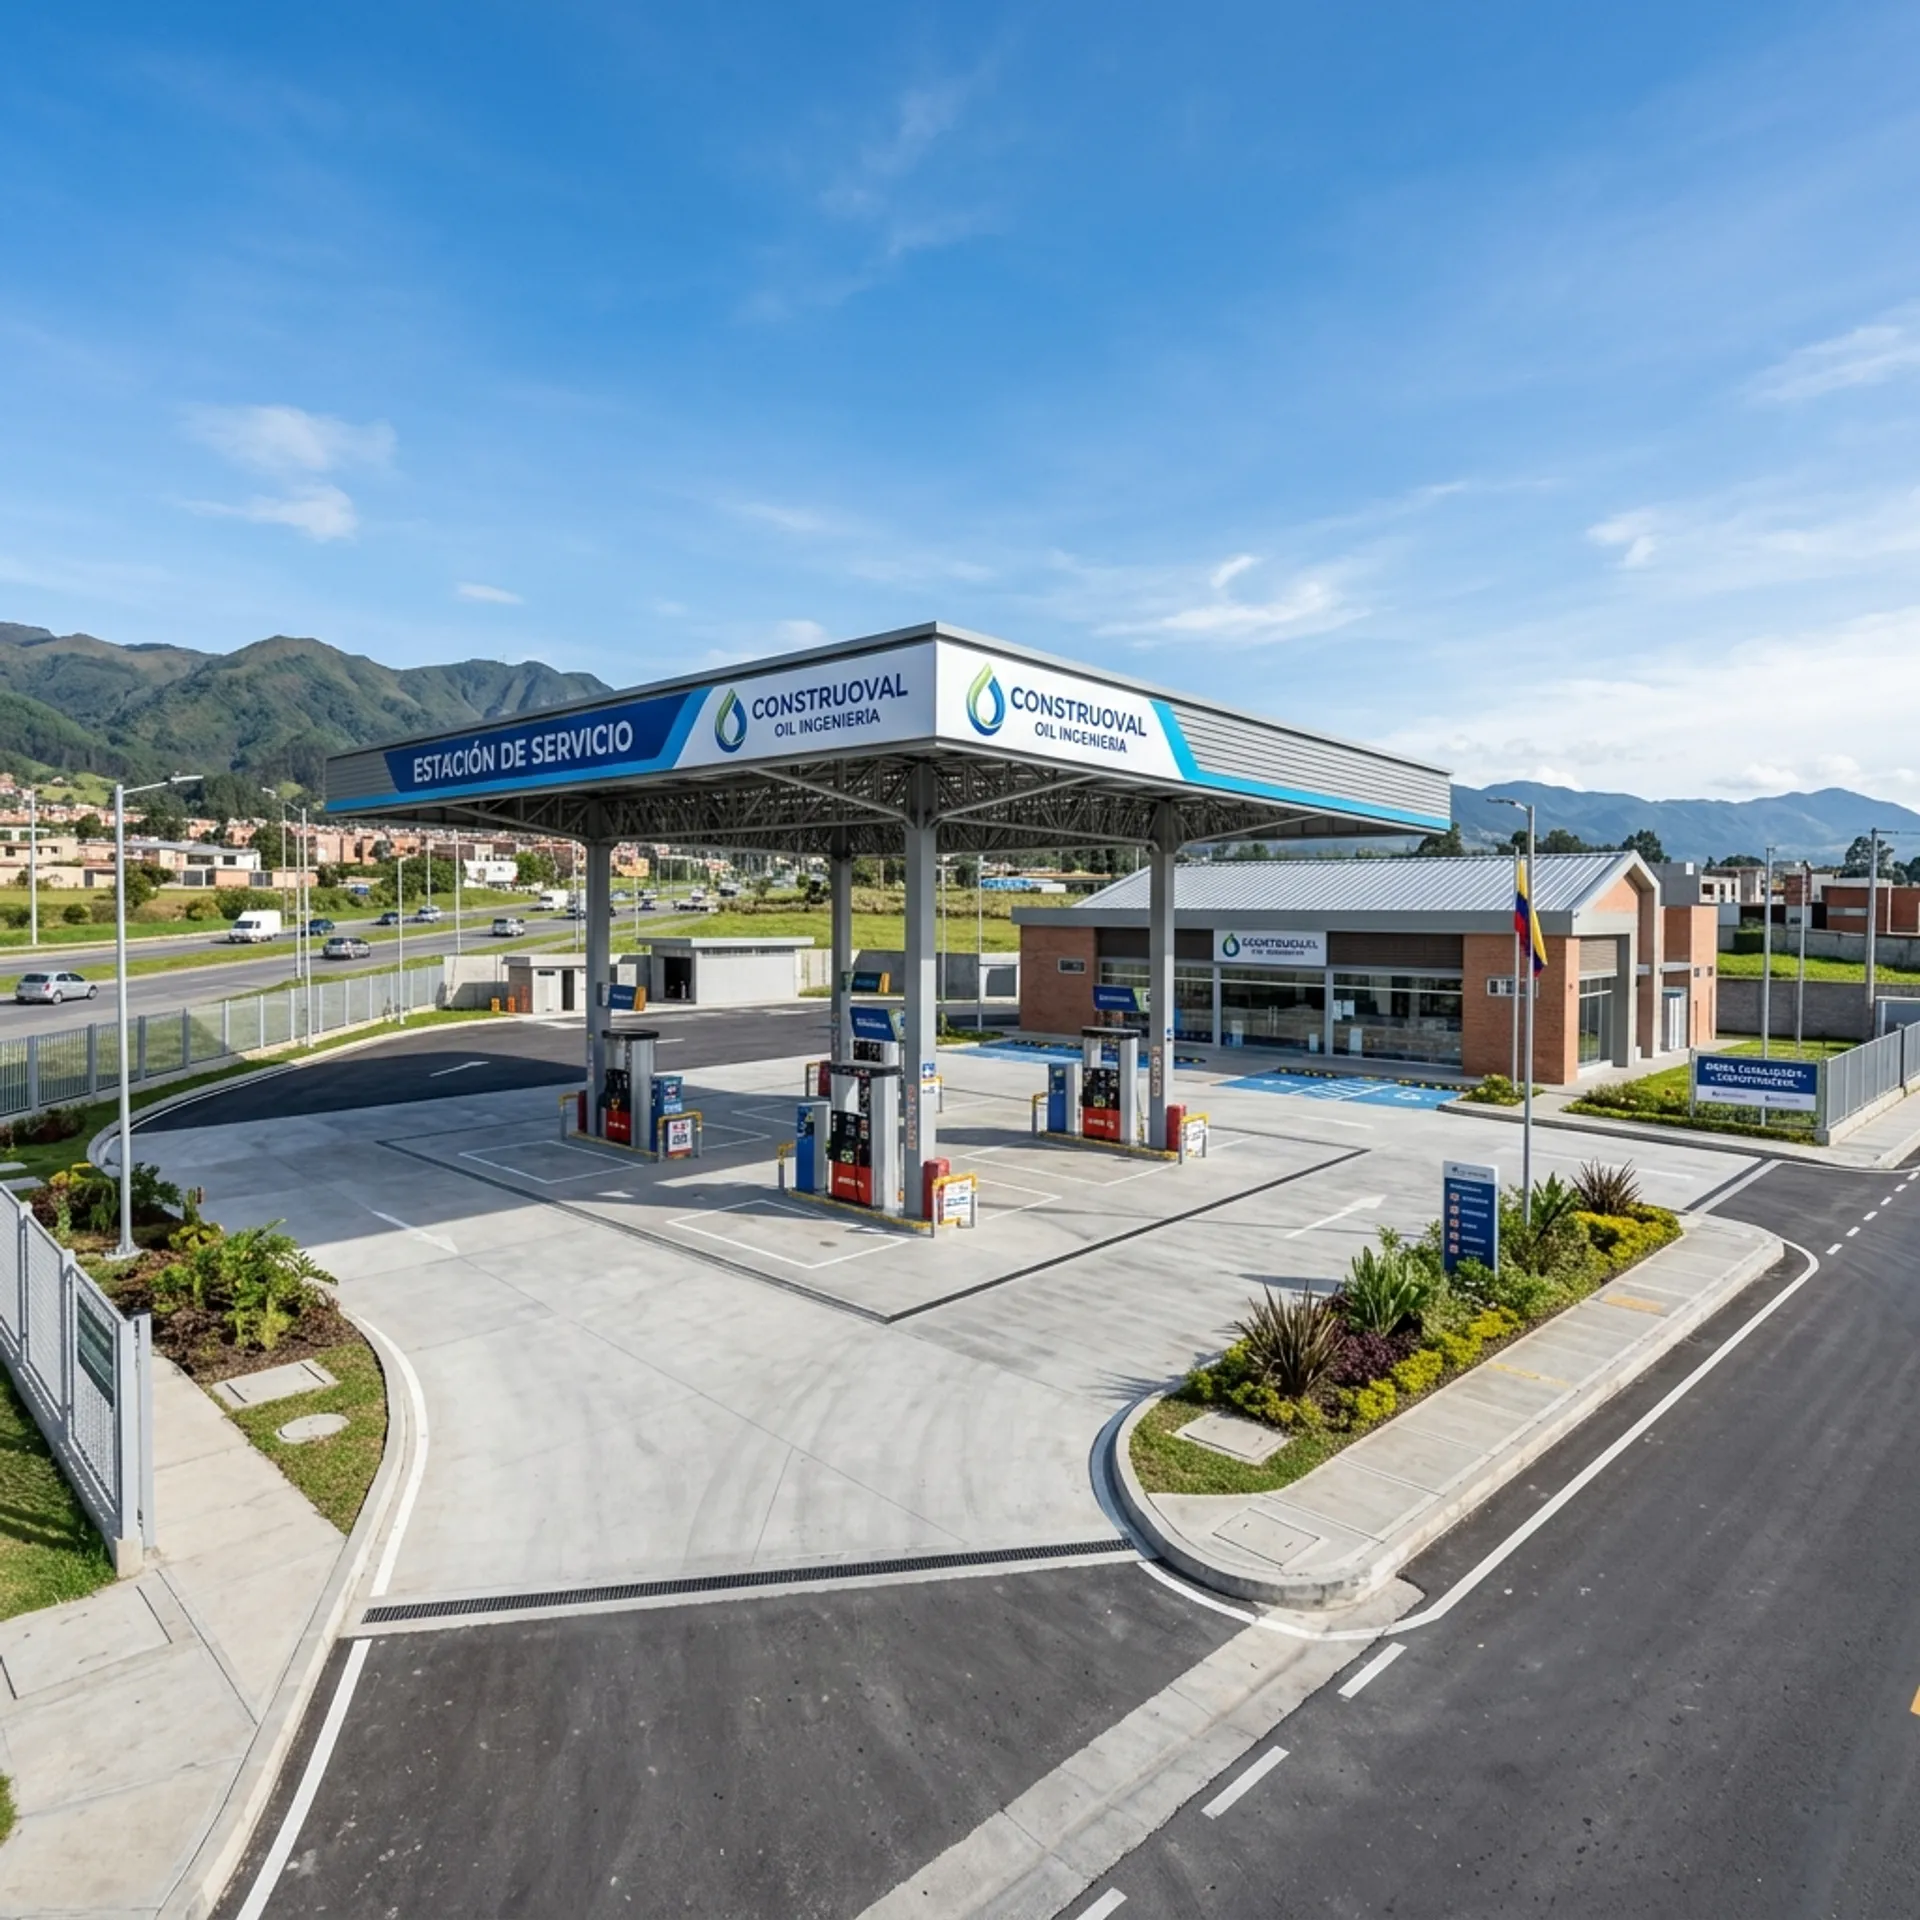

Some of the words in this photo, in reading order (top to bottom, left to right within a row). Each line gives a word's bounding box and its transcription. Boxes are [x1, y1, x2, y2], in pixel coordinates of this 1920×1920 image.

[752, 673, 908, 720] CONSTRUOVAL
[1010, 686, 1147, 737] CONSTRUOVAL
[413, 740, 496, 784] ESTACIÓN
[500, 739, 526, 770] DE
[531, 719, 634, 765] SERVICIO
[774, 721, 796, 738] OIL
[1034, 721, 1057, 740] OIL
